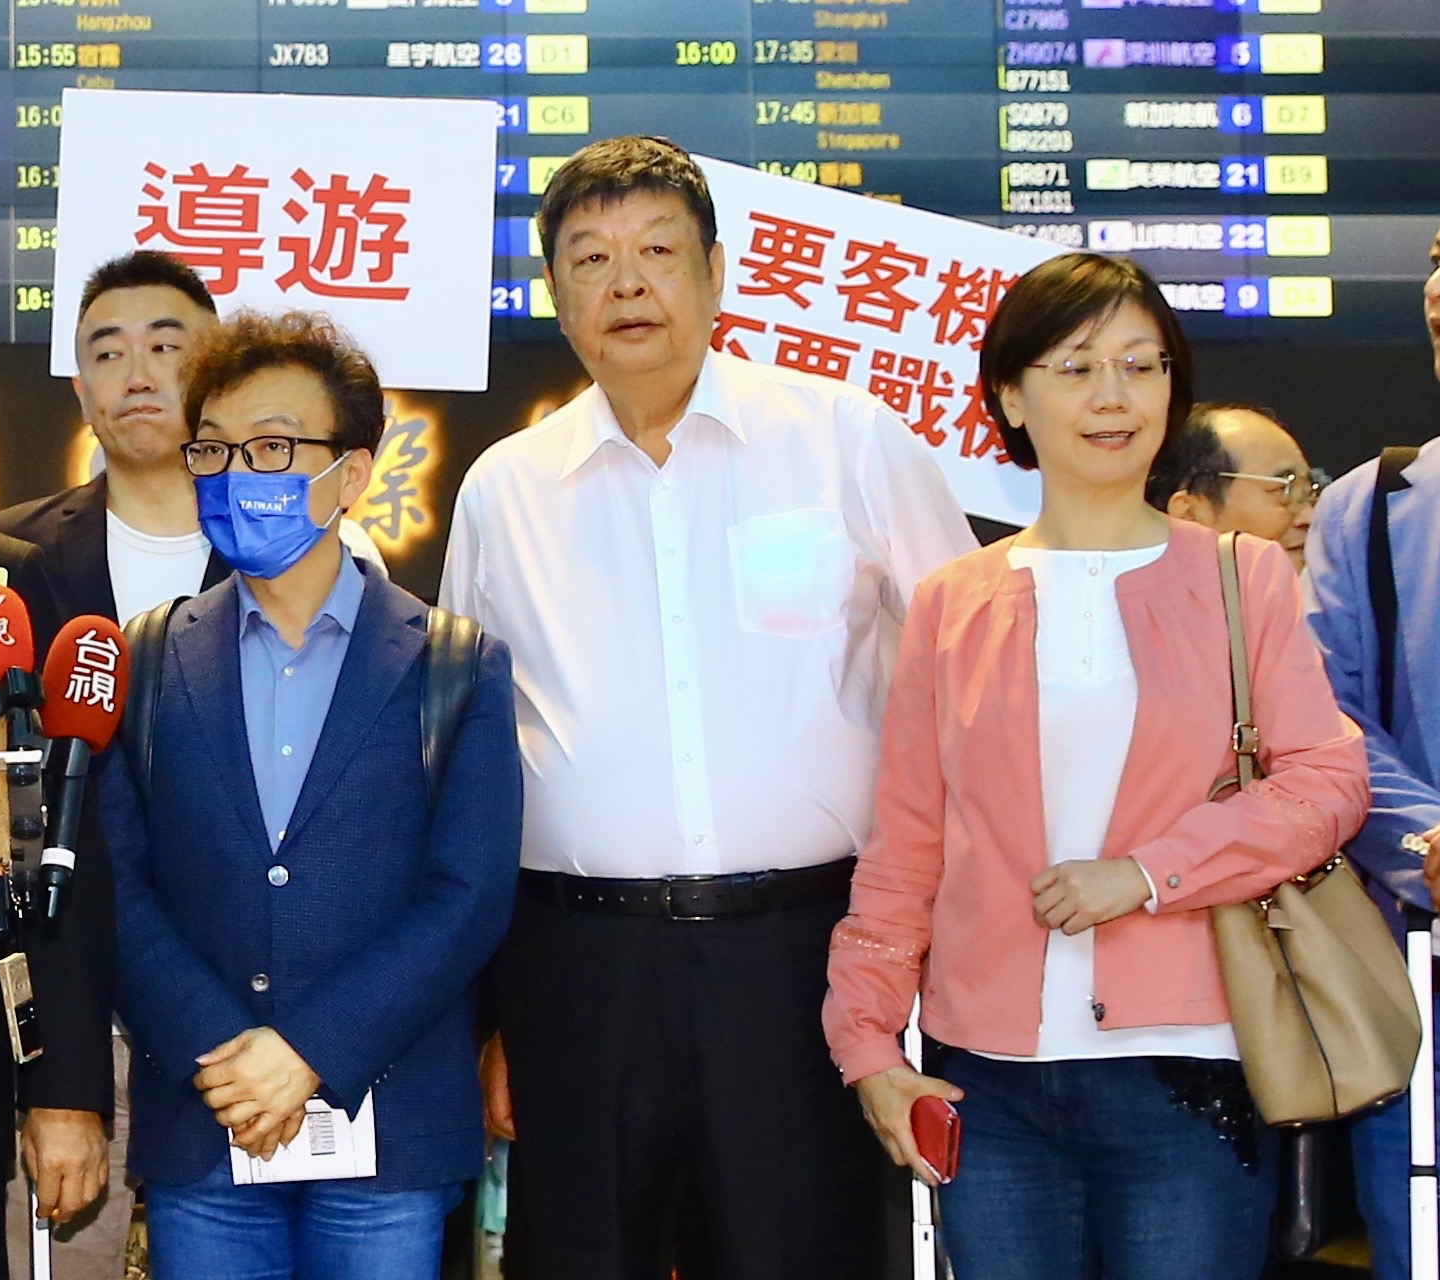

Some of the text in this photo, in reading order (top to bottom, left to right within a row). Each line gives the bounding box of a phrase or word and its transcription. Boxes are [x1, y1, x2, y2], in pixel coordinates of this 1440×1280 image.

[16, 43, 76, 67] 15:55
[269, 43, 330, 67] JX783
[386, 42, 481, 68] 星宇航空
[487, 43, 523, 67] 26
[675, 41, 737, 66] 16:00
[16, 105, 62, 128] 16:0
[541, 105, 575, 124] C6
[756, 101, 816, 125] 17:45
[1277, 105, 1310, 124] D7
[498, 165, 517, 187] 7
[1226, 163, 1260, 188] 21
[133, 161, 413, 302] 導遊
[1228, 223, 1265, 248] 22
[737, 210, 1022, 352] 要客機
[492, 287, 524, 310] 21
[239, 498, 283, 513] TAIWAN
[64, 629, 120, 713] 台視
